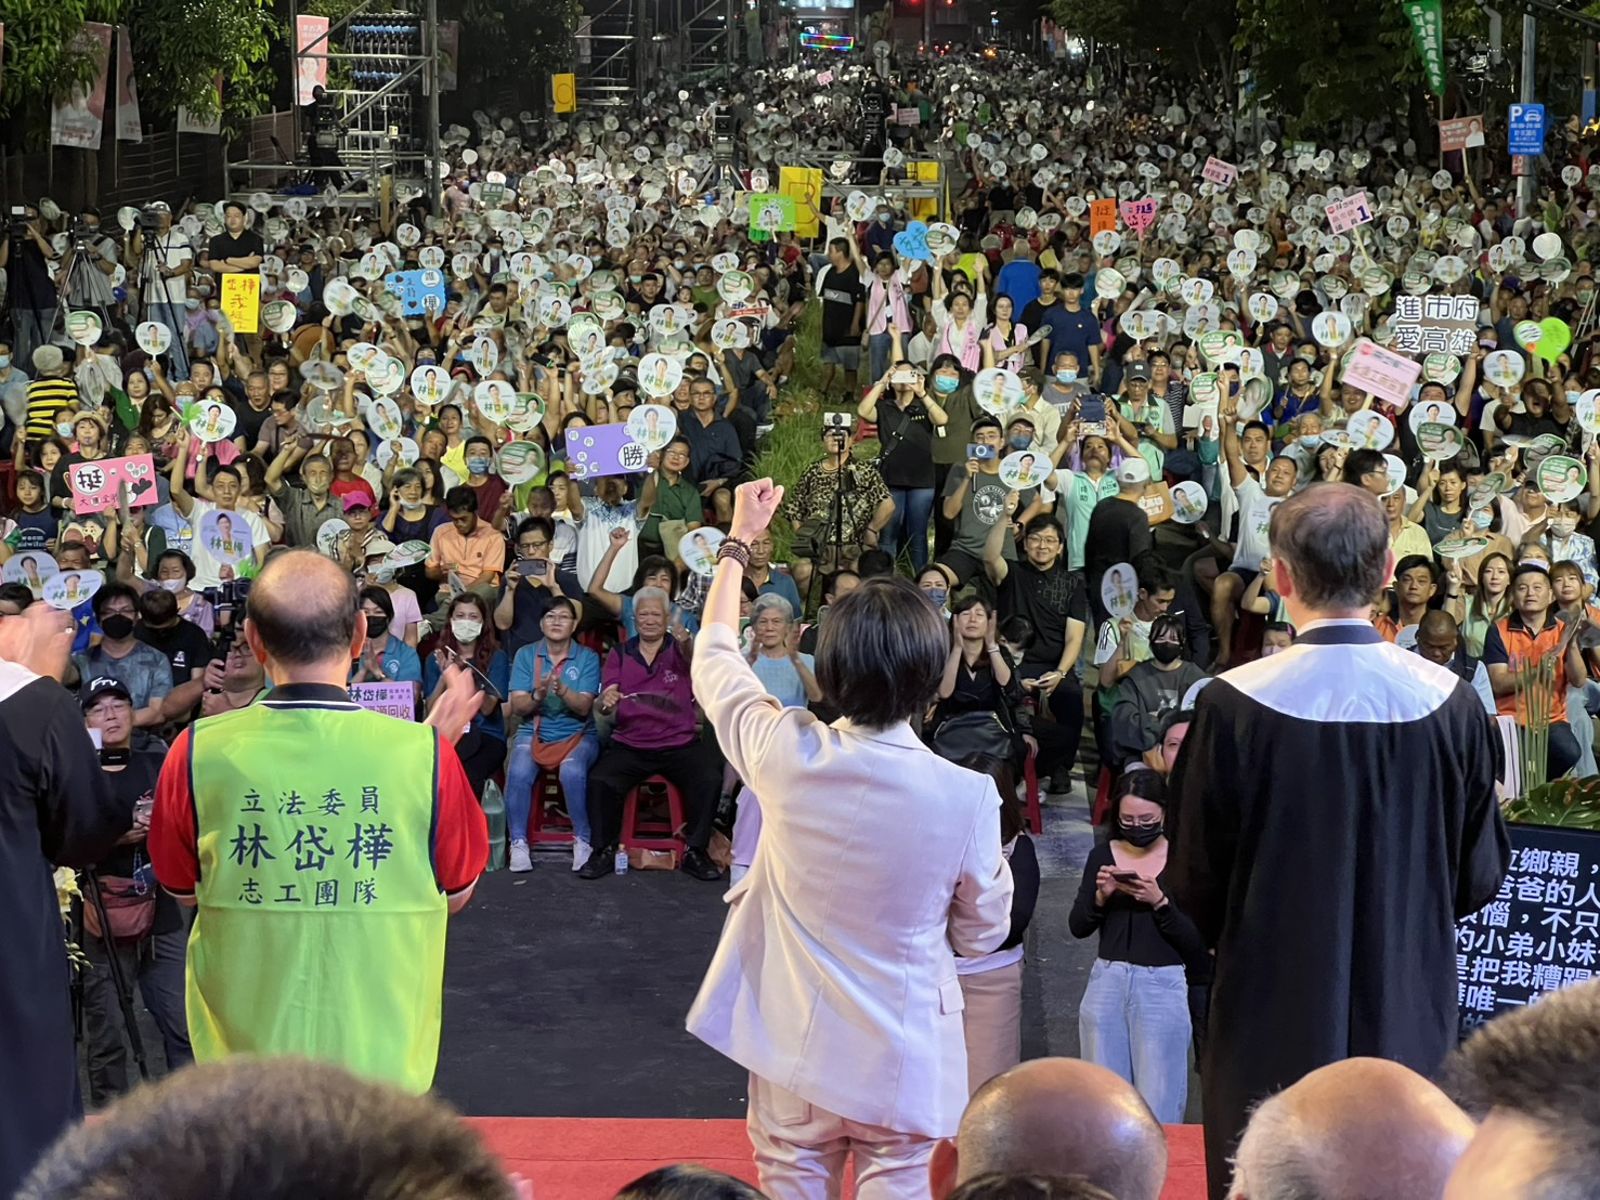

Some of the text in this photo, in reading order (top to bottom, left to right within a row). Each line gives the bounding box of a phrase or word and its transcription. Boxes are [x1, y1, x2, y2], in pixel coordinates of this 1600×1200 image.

[1511, 106, 1522, 122] P
[1221, 174, 1229, 183] 1
[1357, 205, 1370, 221] 1
[1397, 296, 1478, 320] 進市府
[1396, 326, 1476, 354] 愛高雄
[623, 445, 644, 466] 勝
[78, 469, 102, 490] 挺
[91, 677, 118, 691] FTV
[240, 786, 379, 816] 立法委員
[229, 823, 394, 871] 林岱樺
[238, 877, 378, 906] 志工團隊
[1459, 900, 1600, 938] 惱，不只
